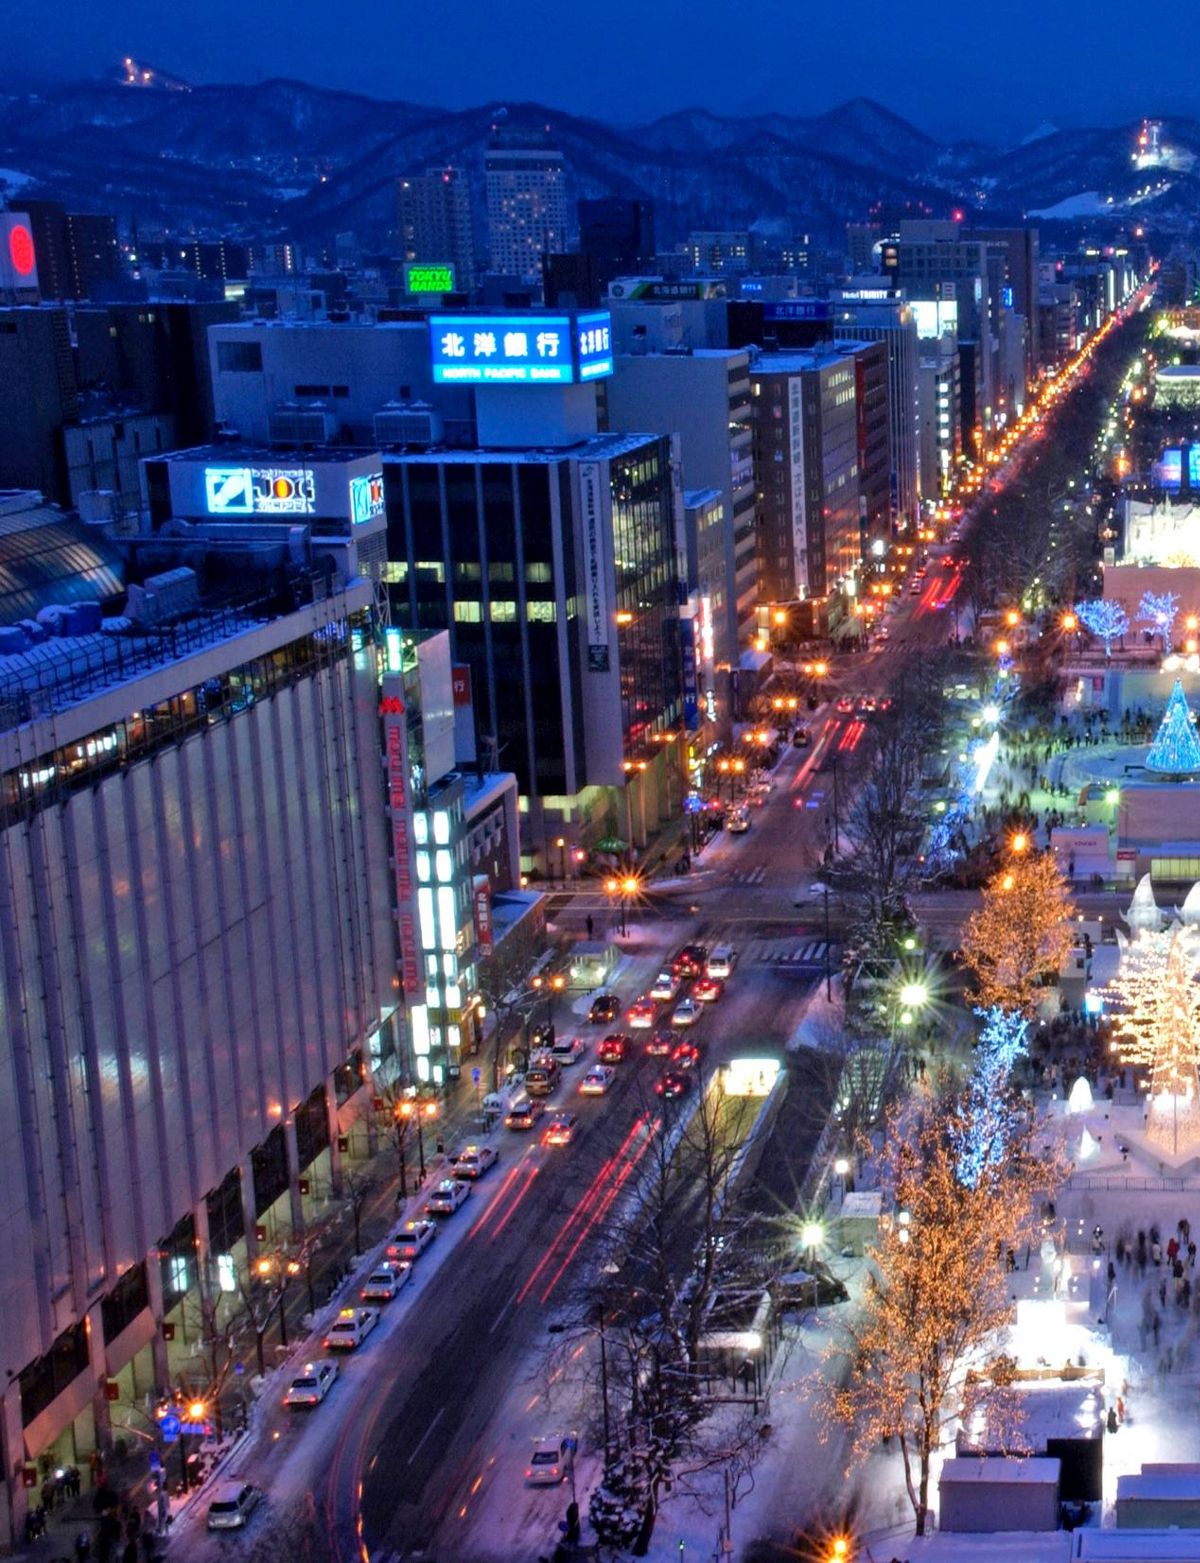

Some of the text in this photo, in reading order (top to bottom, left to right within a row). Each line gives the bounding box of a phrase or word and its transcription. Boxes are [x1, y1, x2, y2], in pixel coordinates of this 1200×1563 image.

[441, 332, 560, 357] 北洋銀行
[442, 368, 481, 378] NORTH
[484, 368, 526, 378] PACIFIC
